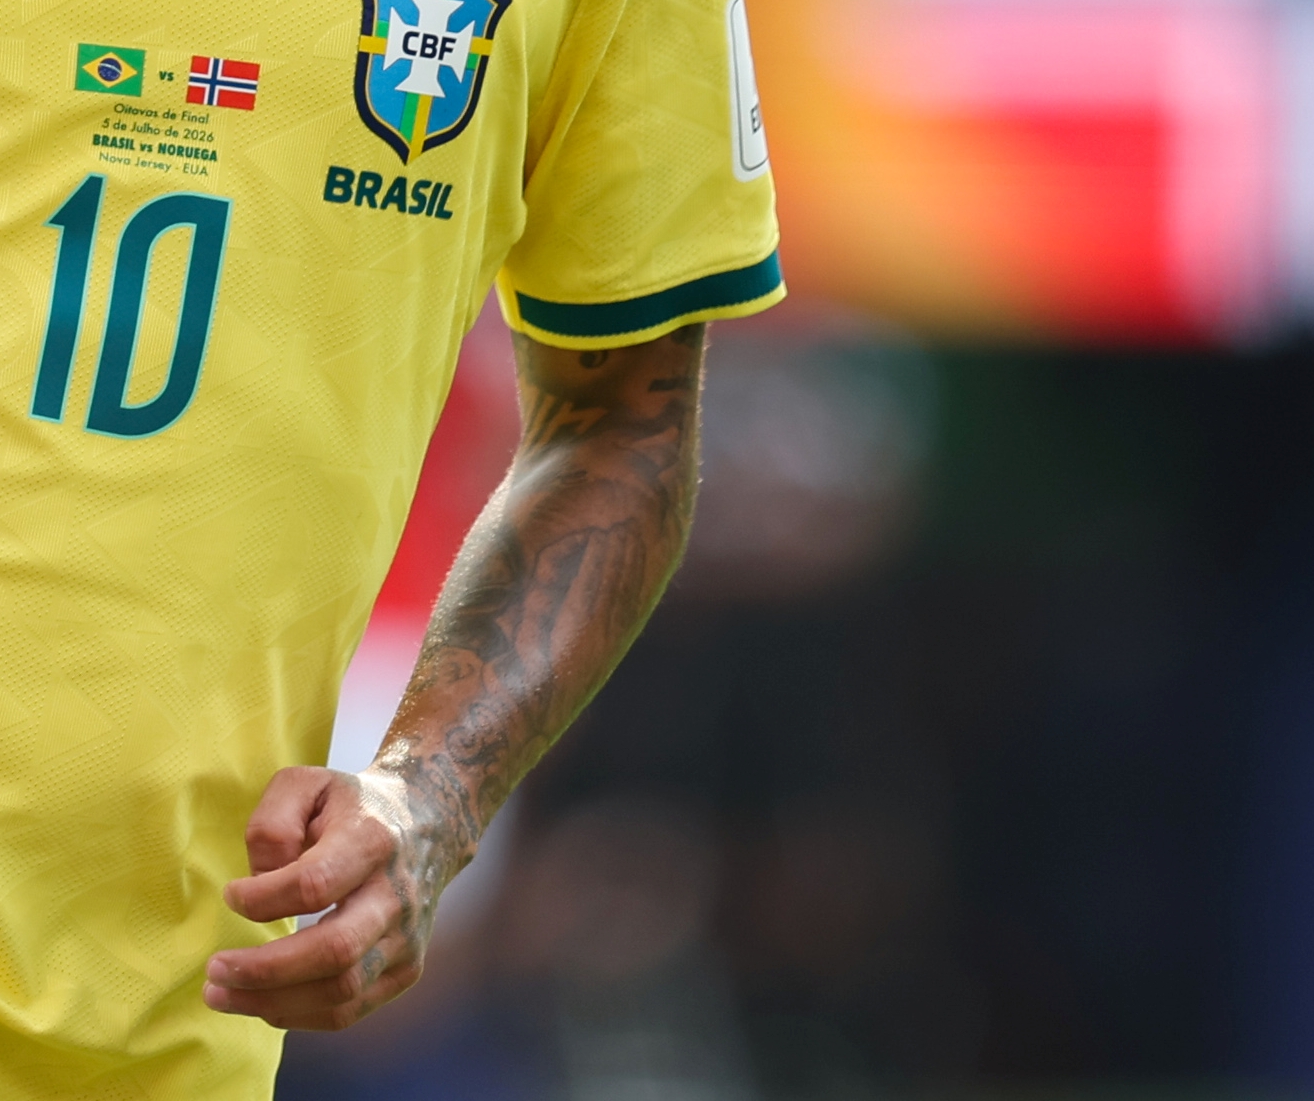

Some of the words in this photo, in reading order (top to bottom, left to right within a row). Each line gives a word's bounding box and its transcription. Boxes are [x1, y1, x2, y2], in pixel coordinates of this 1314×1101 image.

[402, 30, 457, 61] CBF
[113, 103, 159, 118] Oitavas
[162, 109, 177, 120] de
[181, 111, 209, 124] Final
[102, 118, 110, 129] 5
[113, 120, 127, 131] de
[131, 122, 160, 136] Julho
[165, 126, 179, 138] de
[183, 128, 215, 142] 2026
[92, 134, 135, 151] BRASIL
[140, 143, 153, 152] vs
[158, 143, 218, 162] NORUEGA
[99, 152, 131, 166] Nova
[135, 157, 172, 172] Jersey
[183, 163, 208, 176] EUA
[323, 165, 453, 220] BRASIL
[28, 171, 234, 440] 10
